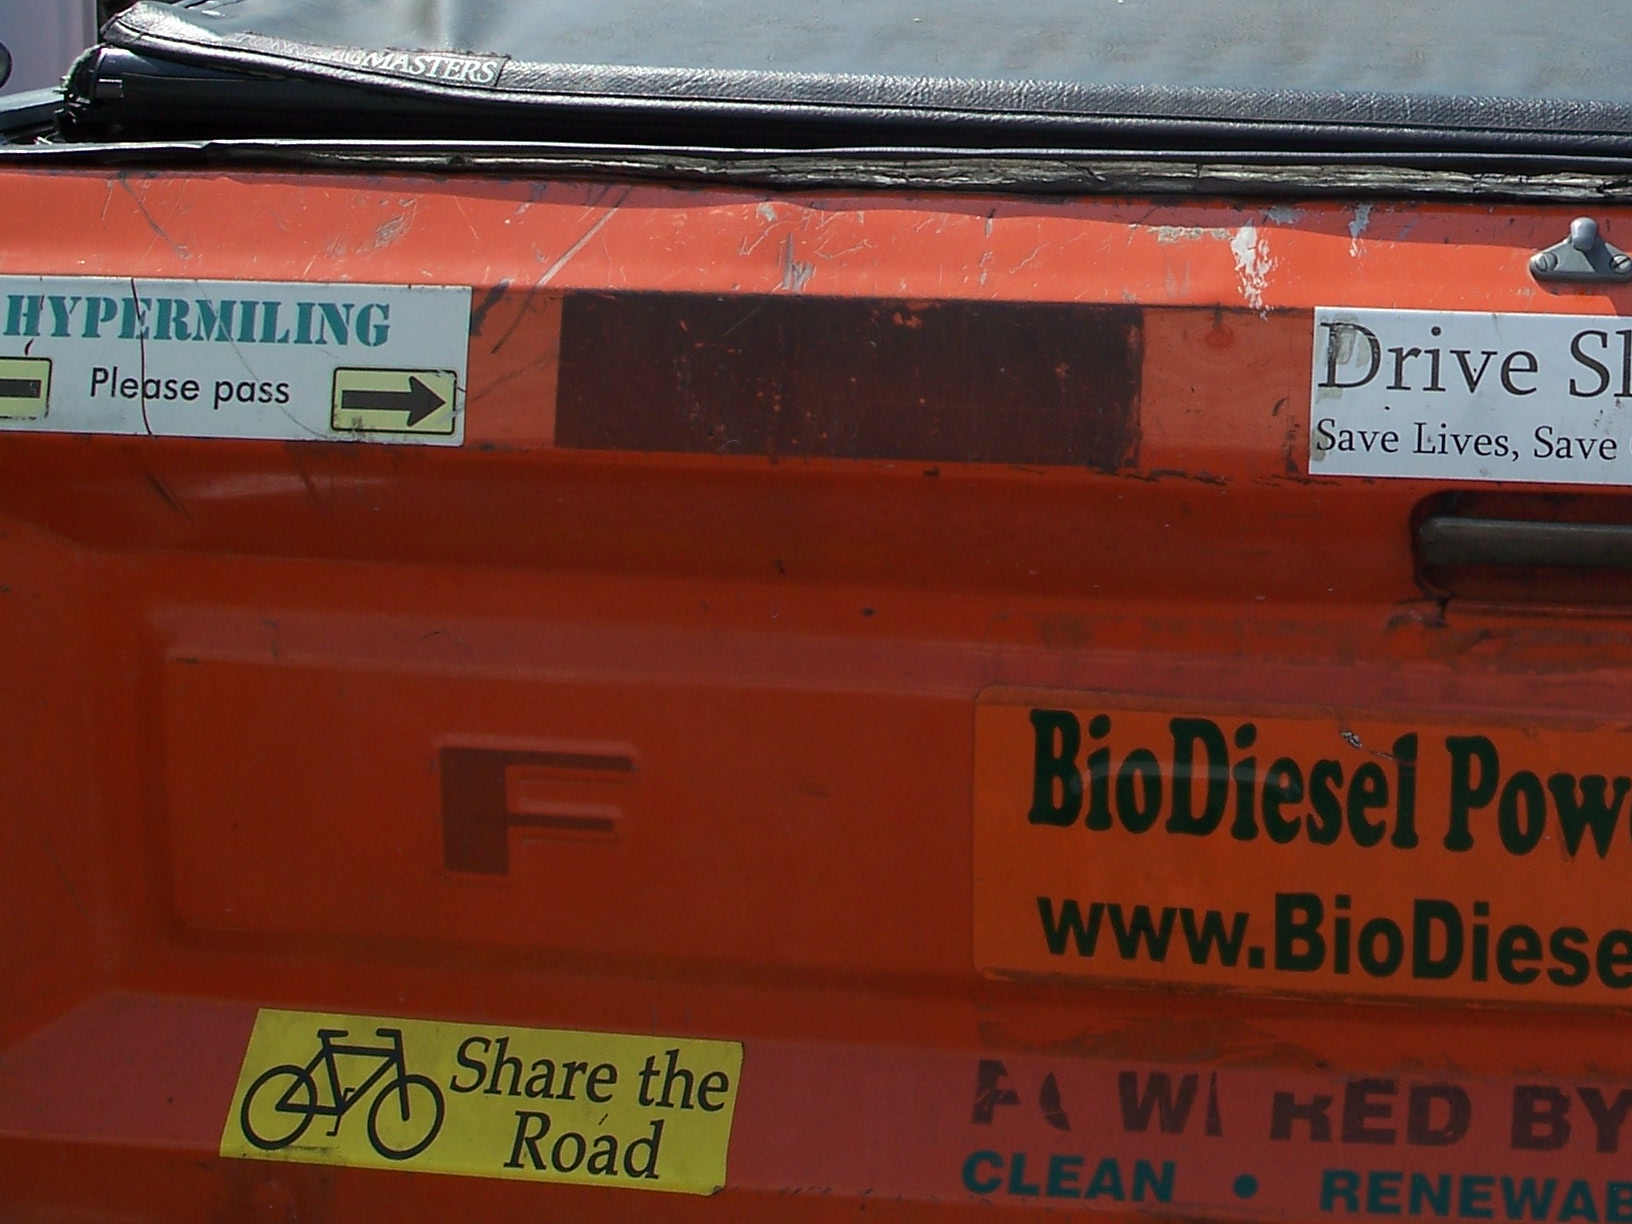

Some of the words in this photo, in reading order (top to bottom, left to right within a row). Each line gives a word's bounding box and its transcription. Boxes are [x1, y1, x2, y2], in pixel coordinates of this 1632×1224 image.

[3, 294, 391, 348] HYPERMILING
[90, 367, 200, 401] Please
[213, 375, 290, 409] pass
[1317, 321, 1539, 396] Drive
[1316, 419, 1399, 454] Save
[1412, 422, 1520, 462] Lives,
[1533, 426, 1618, 461] Save
[1028, 708, 1419, 852] BioDiesel
[450, 1036, 617, 1102] Share
[637, 1049, 730, 1112] the
[503, 1111, 665, 1180] Road
[961, 1150, 1176, 1203] CLEAN
